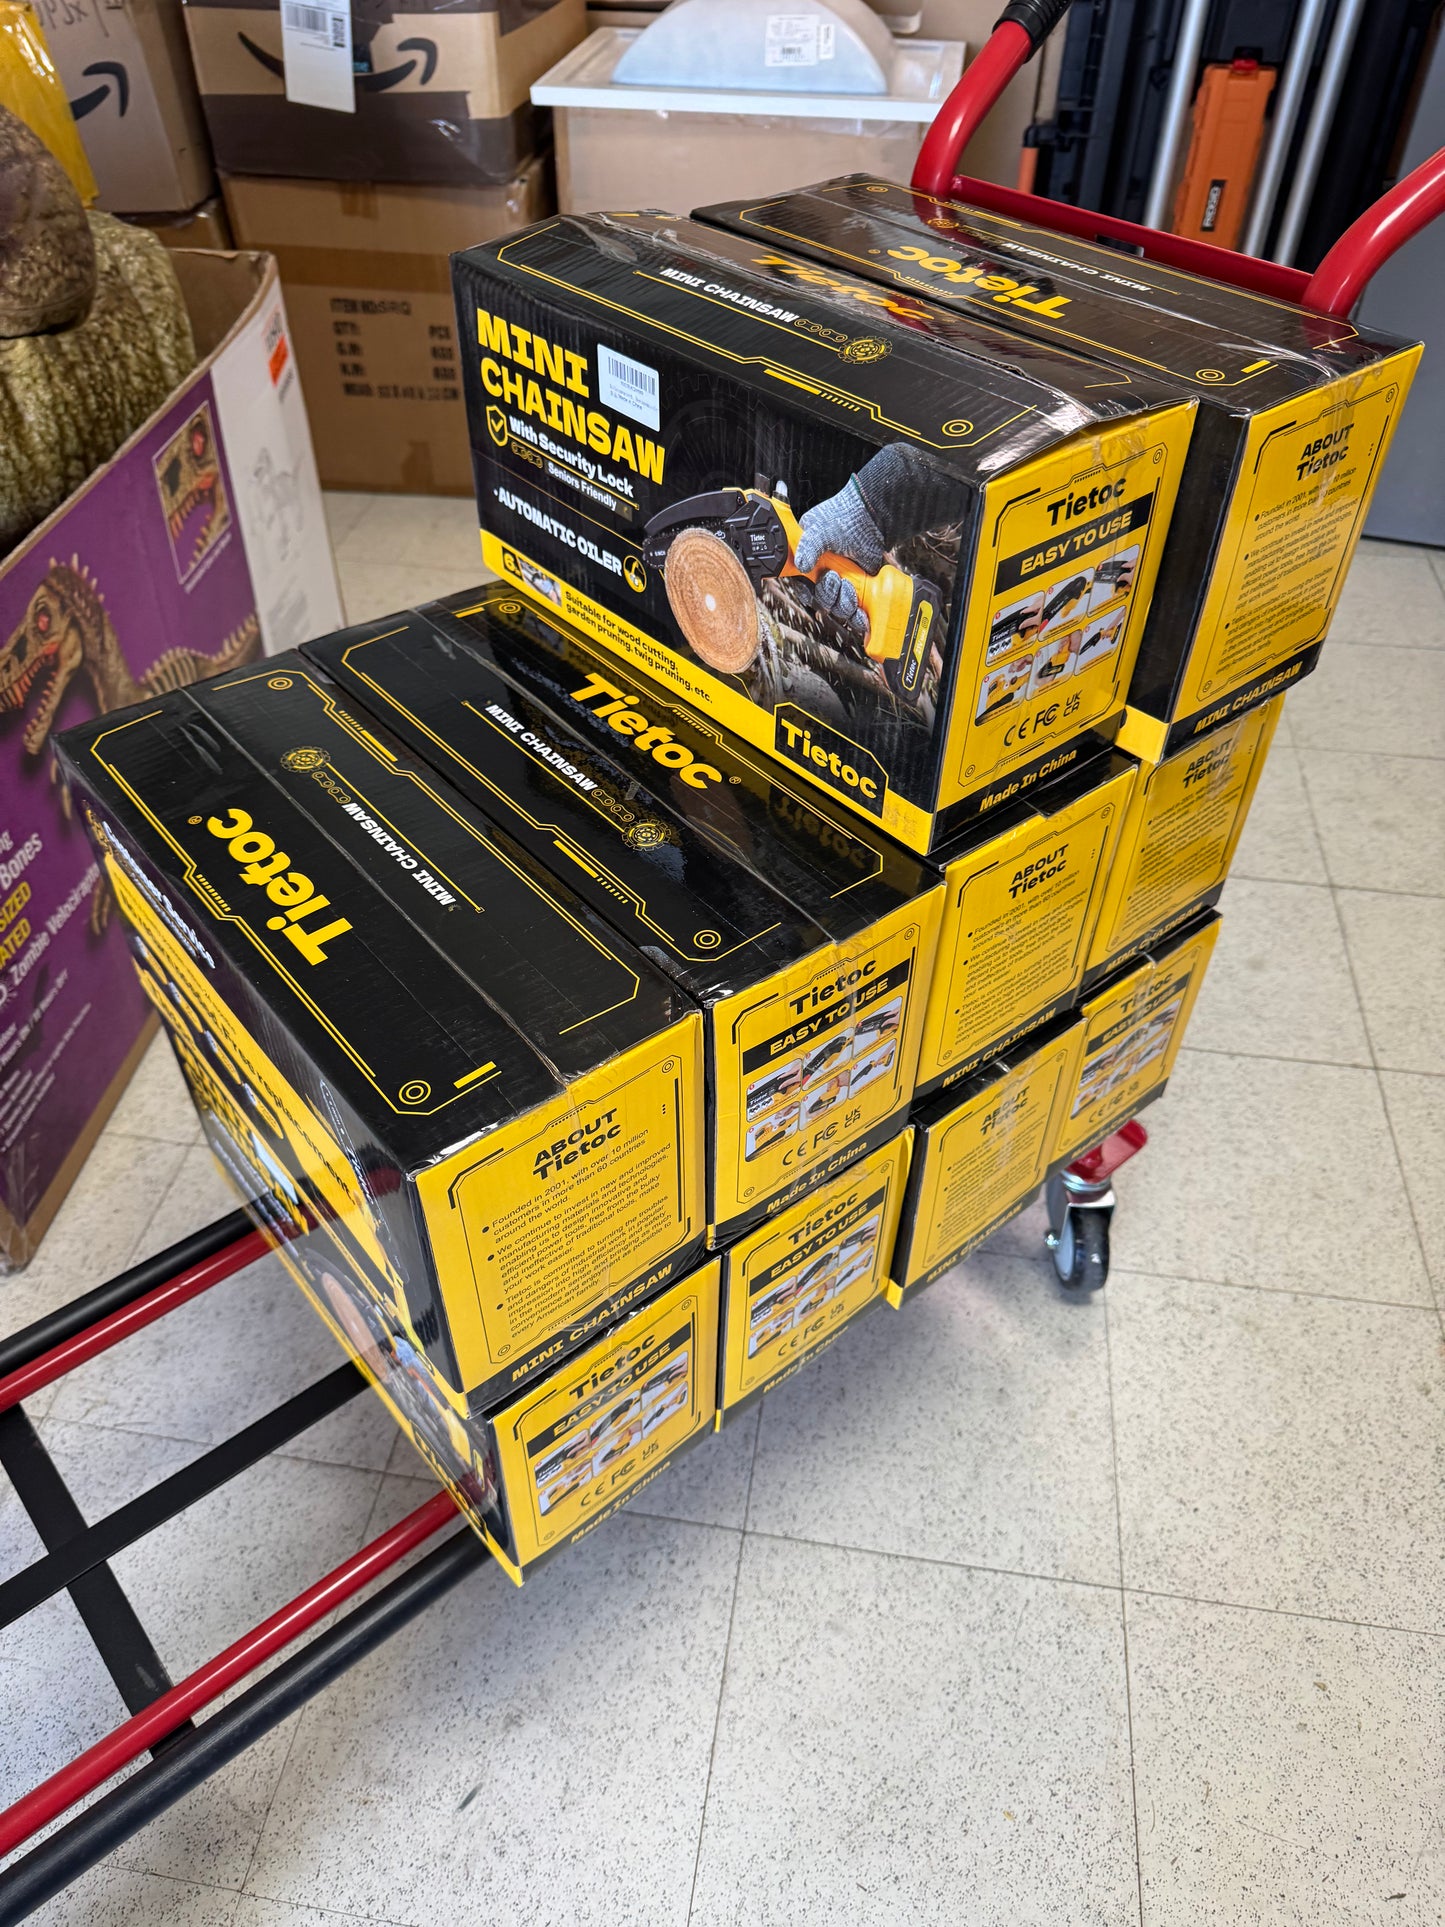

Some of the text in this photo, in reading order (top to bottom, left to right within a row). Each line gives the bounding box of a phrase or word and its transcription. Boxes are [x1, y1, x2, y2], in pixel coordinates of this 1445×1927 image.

[659, 266, 800, 323] MINI CHAINSAW
[887, 245, 1072, 319] Tietoc
[1002, 242, 1152, 292] MINI CHAINSAW
[477, 308, 589, 398] MINI
[481, 357, 665, 485] CHAINSAW
[509, 415, 633, 498] With Security Lock
[1301, 423, 1354, 460] ABOUT
[548, 462, 617, 511] Seniors Friendly
[1297, 446, 1349, 481] Tietoc
[499, 487, 622, 577] AUTOMATIC OILER
[750, 533, 765, 542] Tietoc
[1047, 478, 1127, 526] Tietoc
[1020, 510, 1133, 576] EASY TO USE
[566, 591, 601, 621] Suitable
[602, 612, 616, 629] for
[617, 621, 640, 645] wood
[566, 603, 597, 628] garden
[634, 643, 654, 668] twig
[694, 685, 713, 703] etc.
[905, 659, 917, 684] Tietoc
[1193, 661, 1303, 735] MINI CHAINSAW
[485, 704, 599, 792] MINI CHAINSAW
[570, 672, 722, 790] Tietoc
[781, 718, 878, 799] Tietoc
[1186, 738, 1234, 775] ABOUT
[979, 749, 1078, 813] Made In China
[206, 808, 353, 966] Tietoc
[342, 802, 457, 906] MINI CHAINSAW
[1009, 859, 1067, 899] Tietoc
[1011, 844, 1069, 885] ABOUT
[770, 977, 889, 1056] EASY TO USE
[789, 958, 877, 1016] Tietoc
[942, 1008, 1057, 1088] MINI CHAINSAW
[530, 1123, 623, 1183] Tietoc
[532, 1108, 618, 1167] ABOUT
[492, 1198, 532, 1228] Founded
[534, 1194, 542, 1202] in
[570, 1166, 588, 1180] with
[590, 1154, 608, 1168] over
[612, 1144, 622, 1156] 10
[622, 1128, 648, 1148] million
[494, 1138, 646, 1236] customers in more than 60 countries
[496, 1142, 672, 1256] We continue to invest in new and improved
[766, 1141, 868, 1213] Made In China
[496, 1220, 526, 1244] around
[528, 1212, 542, 1224] the
[498, 1222, 560, 1264] manufacturing
[562, 1198, 600, 1224] materials
[602, 1186, 616, 1200] and
[500, 1172, 648, 1270] enabling us to design innovative and
[502, 1254, 536, 1278] efficient
[536, 1236, 564, 1258] power
[588, 1210, 604, 1224] free
[606, 1198, 624, 1212] from
[626, 1188, 638, 1200] the
[640, 1174, 660, 1190] bulky
[502, 1272, 520, 1286] and
[522, 1244, 564, 1274] ineffective
[566, 1236, 574, 1246] of
[576, 1210, 614, 1240] traditional
[638, 1182, 660, 1198] make
[770, 1202, 869, 1278] EASY TO USE
[788, 1191, 859, 1245] Tietoc
[504, 1278, 524, 1294] your
[524, 1264, 546, 1280] work
[512, 1262, 672, 1382] MINI CHAINSAW
[553, 1343, 672, 1436] EASY TO USE
[569, 1333, 656, 1400] Tietoc
[570, 1461, 671, 1545] Made In China
